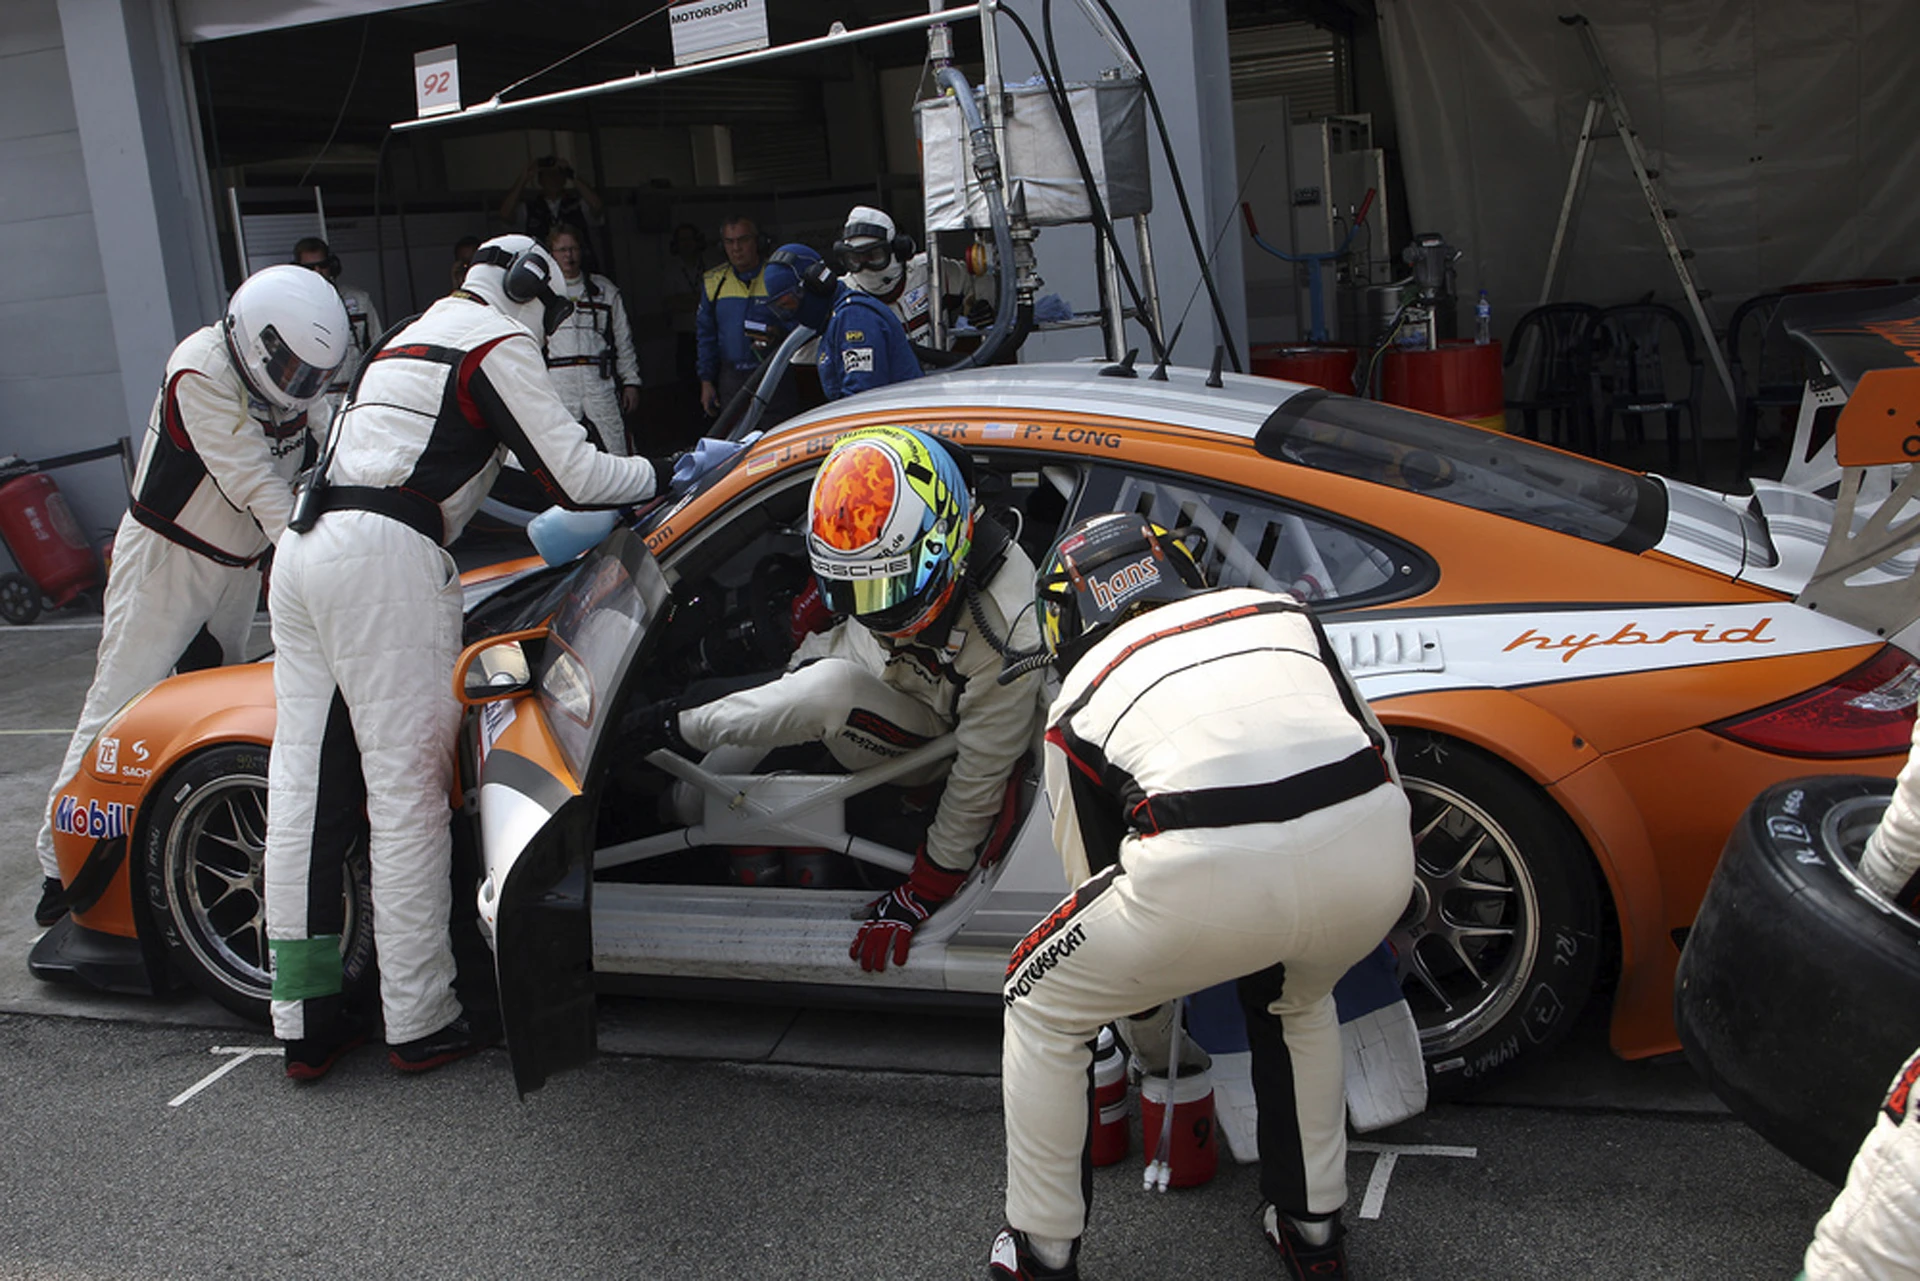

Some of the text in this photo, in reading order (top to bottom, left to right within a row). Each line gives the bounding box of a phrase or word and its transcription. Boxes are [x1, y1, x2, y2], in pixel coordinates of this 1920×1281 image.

[671, 0, 749, 24] MOTORSPORT
[423, 70, 451, 97] 92
[1024, 424, 1122, 449] P. LONG
[1087, 556, 1159, 612] hans
[1502, 617, 1777, 664] hybrid
[55, 795, 123, 840] Mobil
[345, 883, 373, 979] MICHELIN
[1004, 922, 1087, 1008] MOTORSPORT
